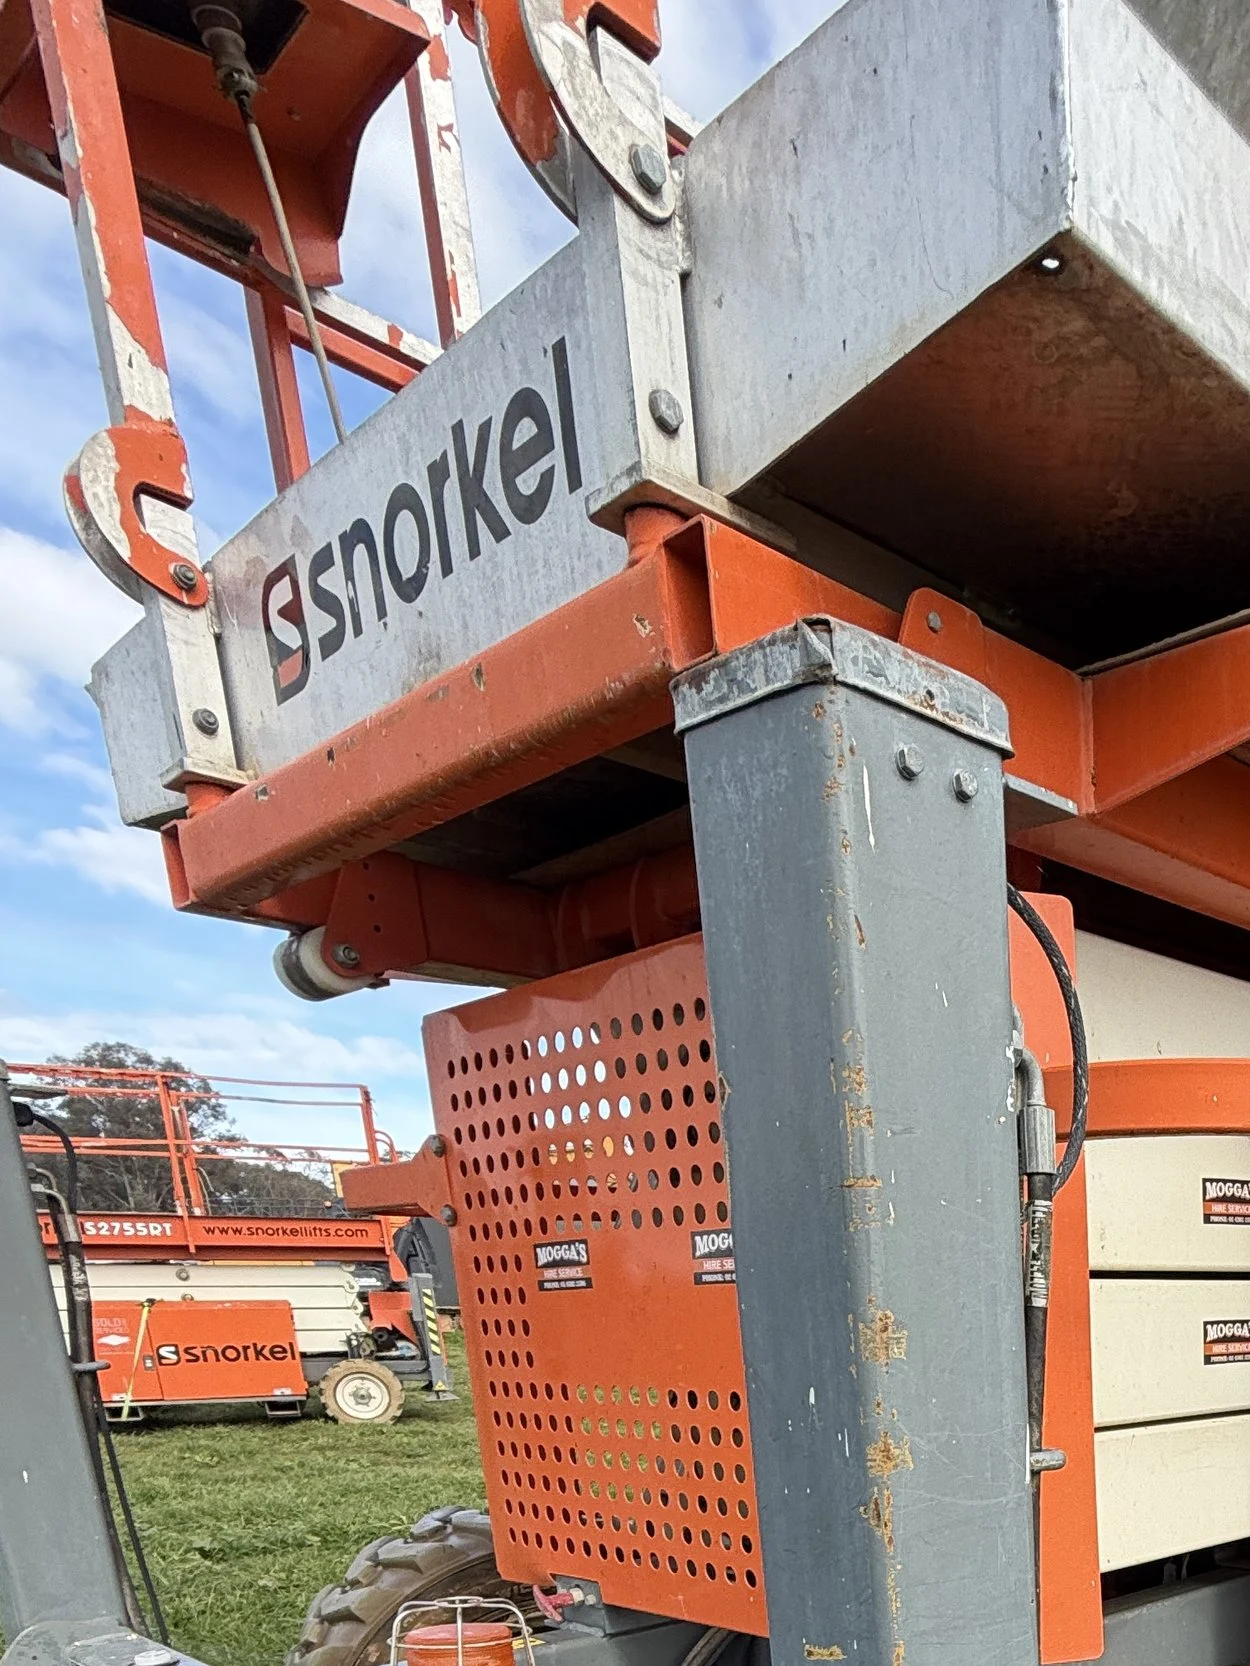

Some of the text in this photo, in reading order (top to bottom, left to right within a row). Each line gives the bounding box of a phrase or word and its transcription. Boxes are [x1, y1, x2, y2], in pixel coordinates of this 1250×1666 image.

[308, 336, 584, 662] snorkel
[83, 1221, 172, 1237] S2755RT
[203, 1225, 369, 1239] www.snorkellifts.com
[536, 1241, 588, 1267] MOGGA'S
[184, 1342, 297, 1363] snorkel
